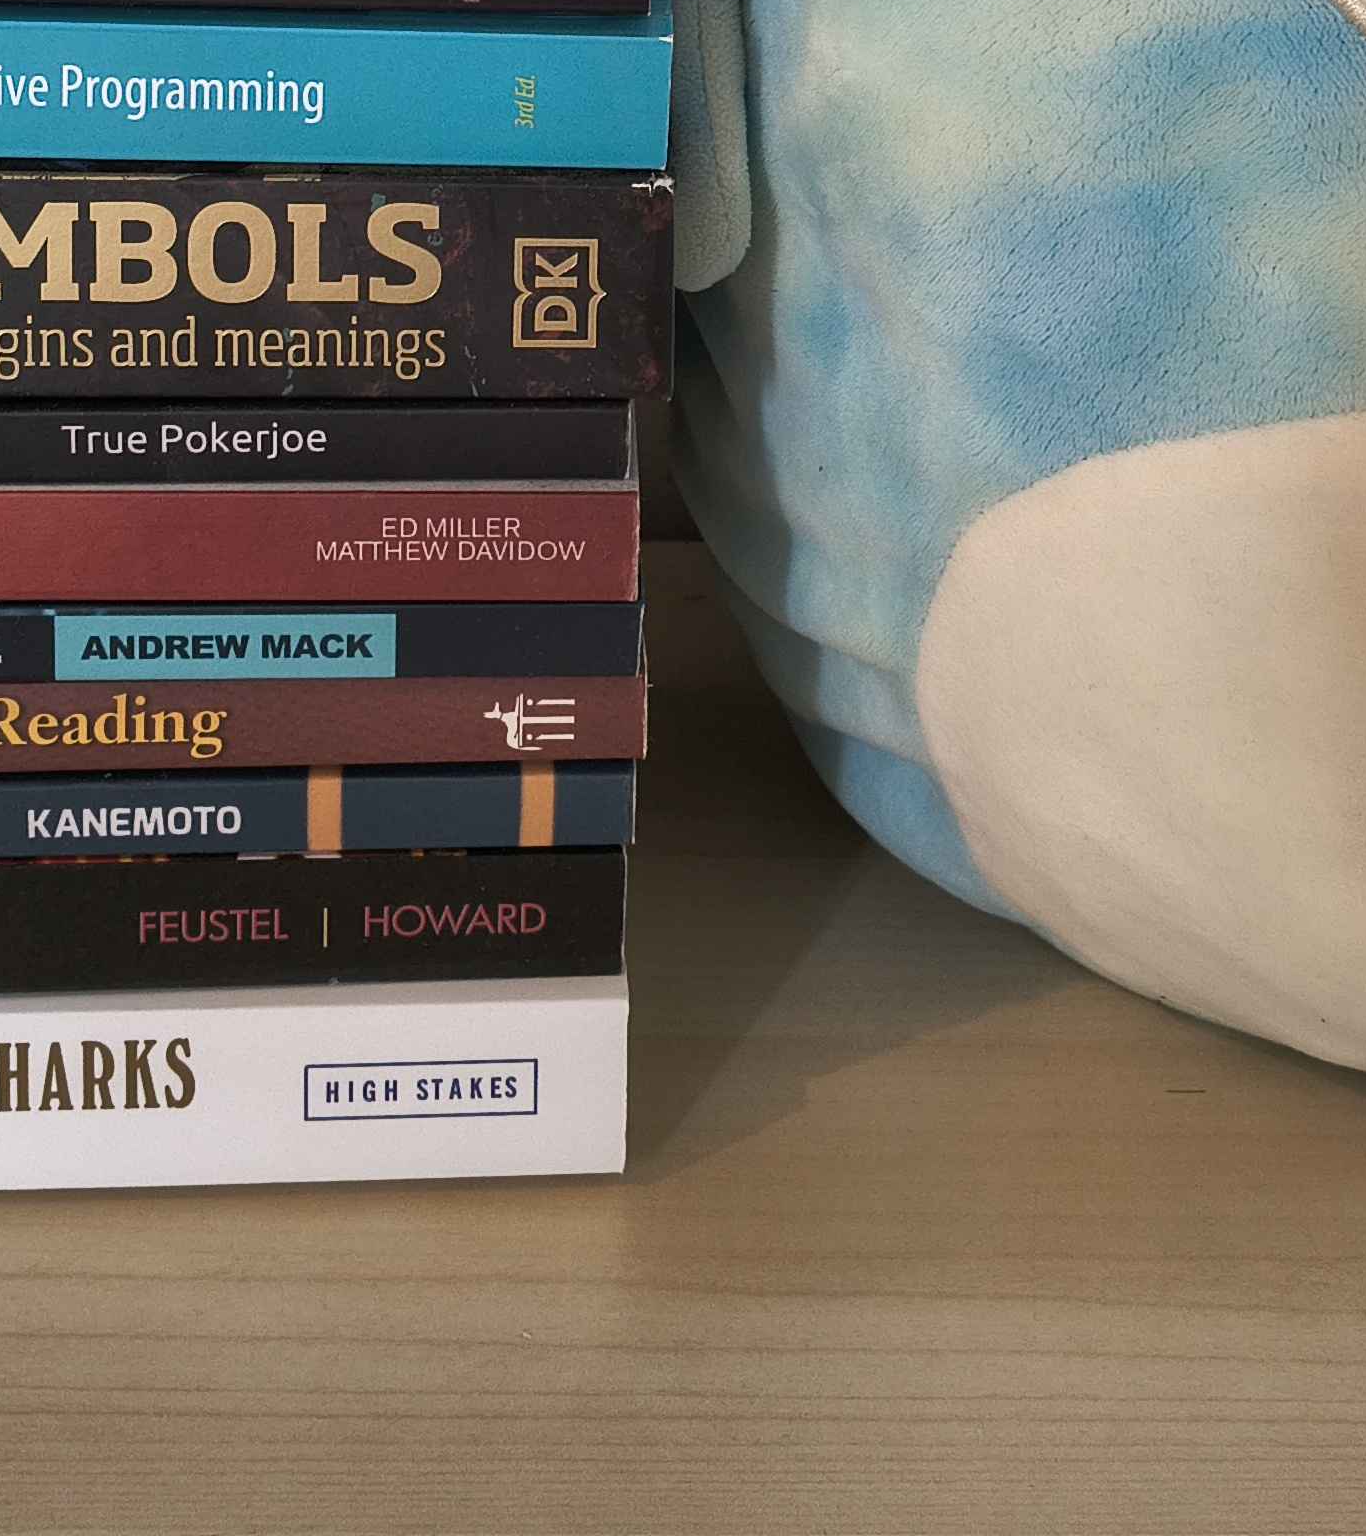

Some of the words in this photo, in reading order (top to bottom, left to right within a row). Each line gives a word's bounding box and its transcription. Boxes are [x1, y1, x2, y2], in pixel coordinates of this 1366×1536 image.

[62, 65, 325, 124] Programming
[514, 75, 537, 98] Ed.
[514, 101, 536, 129] 3rd
[534, 253, 578, 332] DK
[111, 316, 198, 366] and
[215, 316, 445, 379] meanings
[61, 426, 147, 453] True
[162, 421, 327, 459] Pokerjoe
[383, 518, 417, 537] ED
[427, 518, 520, 537] MILLER
[317, 541, 448, 560] MATTHEW
[459, 541, 585, 560] DAVIDOW
[81, 635, 249, 660] ANDREW
[262, 634, 373, 658] MACK
[28, 806, 241, 838] KANEMOTO
[140, 909, 288, 943] FEUSTEL
[365, 903, 546, 937] HOWARD
[326, 1080, 397, 1103] HIGH
[417, 1076, 516, 1100] STAKES
